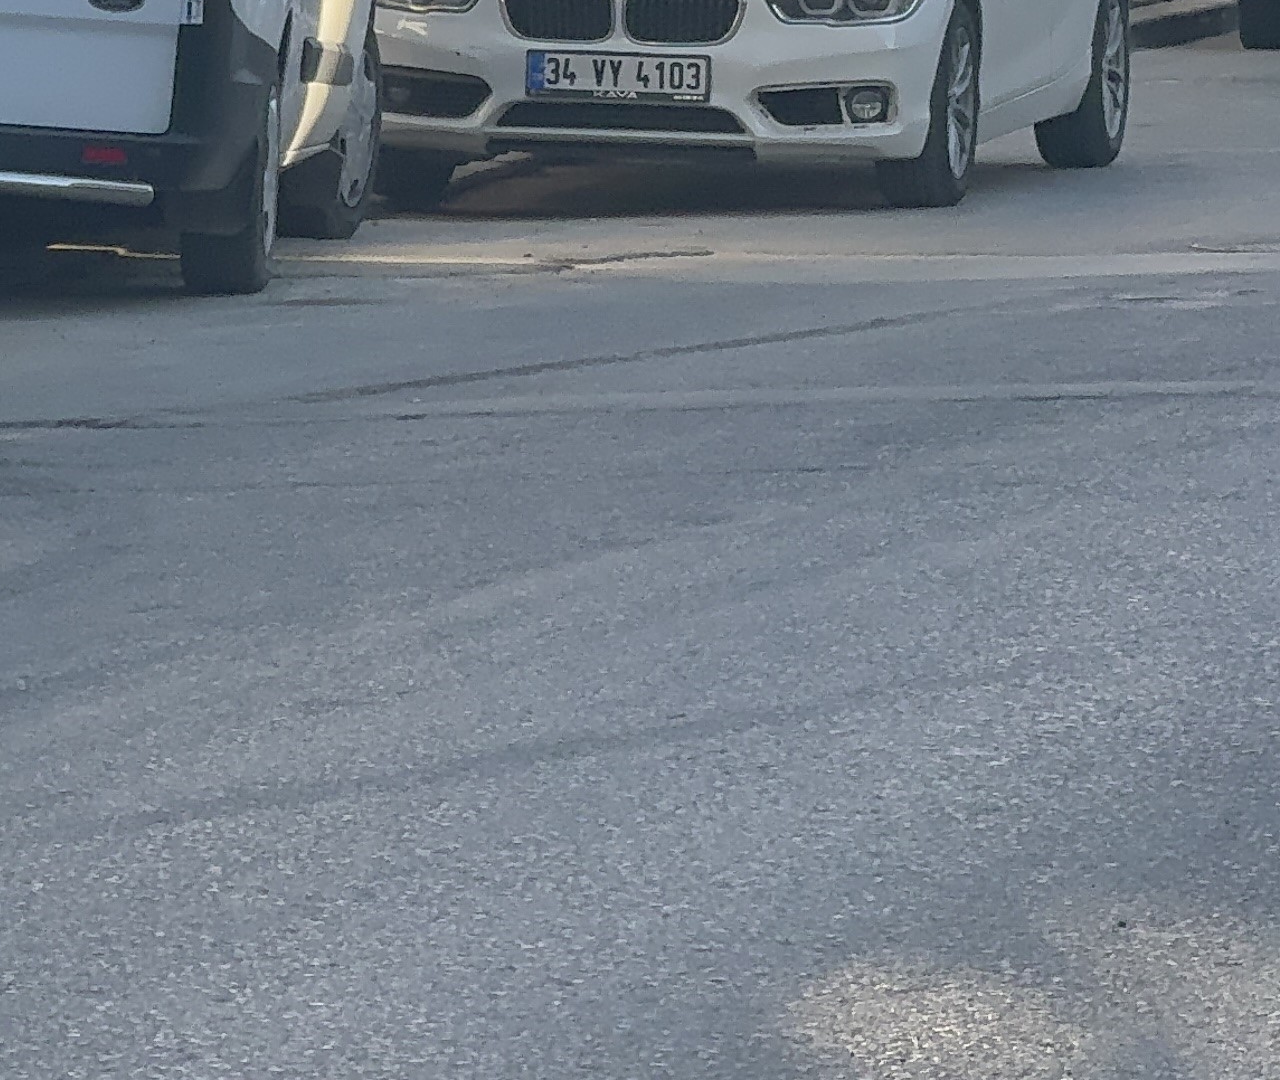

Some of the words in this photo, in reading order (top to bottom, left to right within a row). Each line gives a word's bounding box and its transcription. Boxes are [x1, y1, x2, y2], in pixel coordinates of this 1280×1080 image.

[546, 58, 577, 86] 34
[592, 59, 622, 88] VY
[636, 61, 701, 90] 4103
